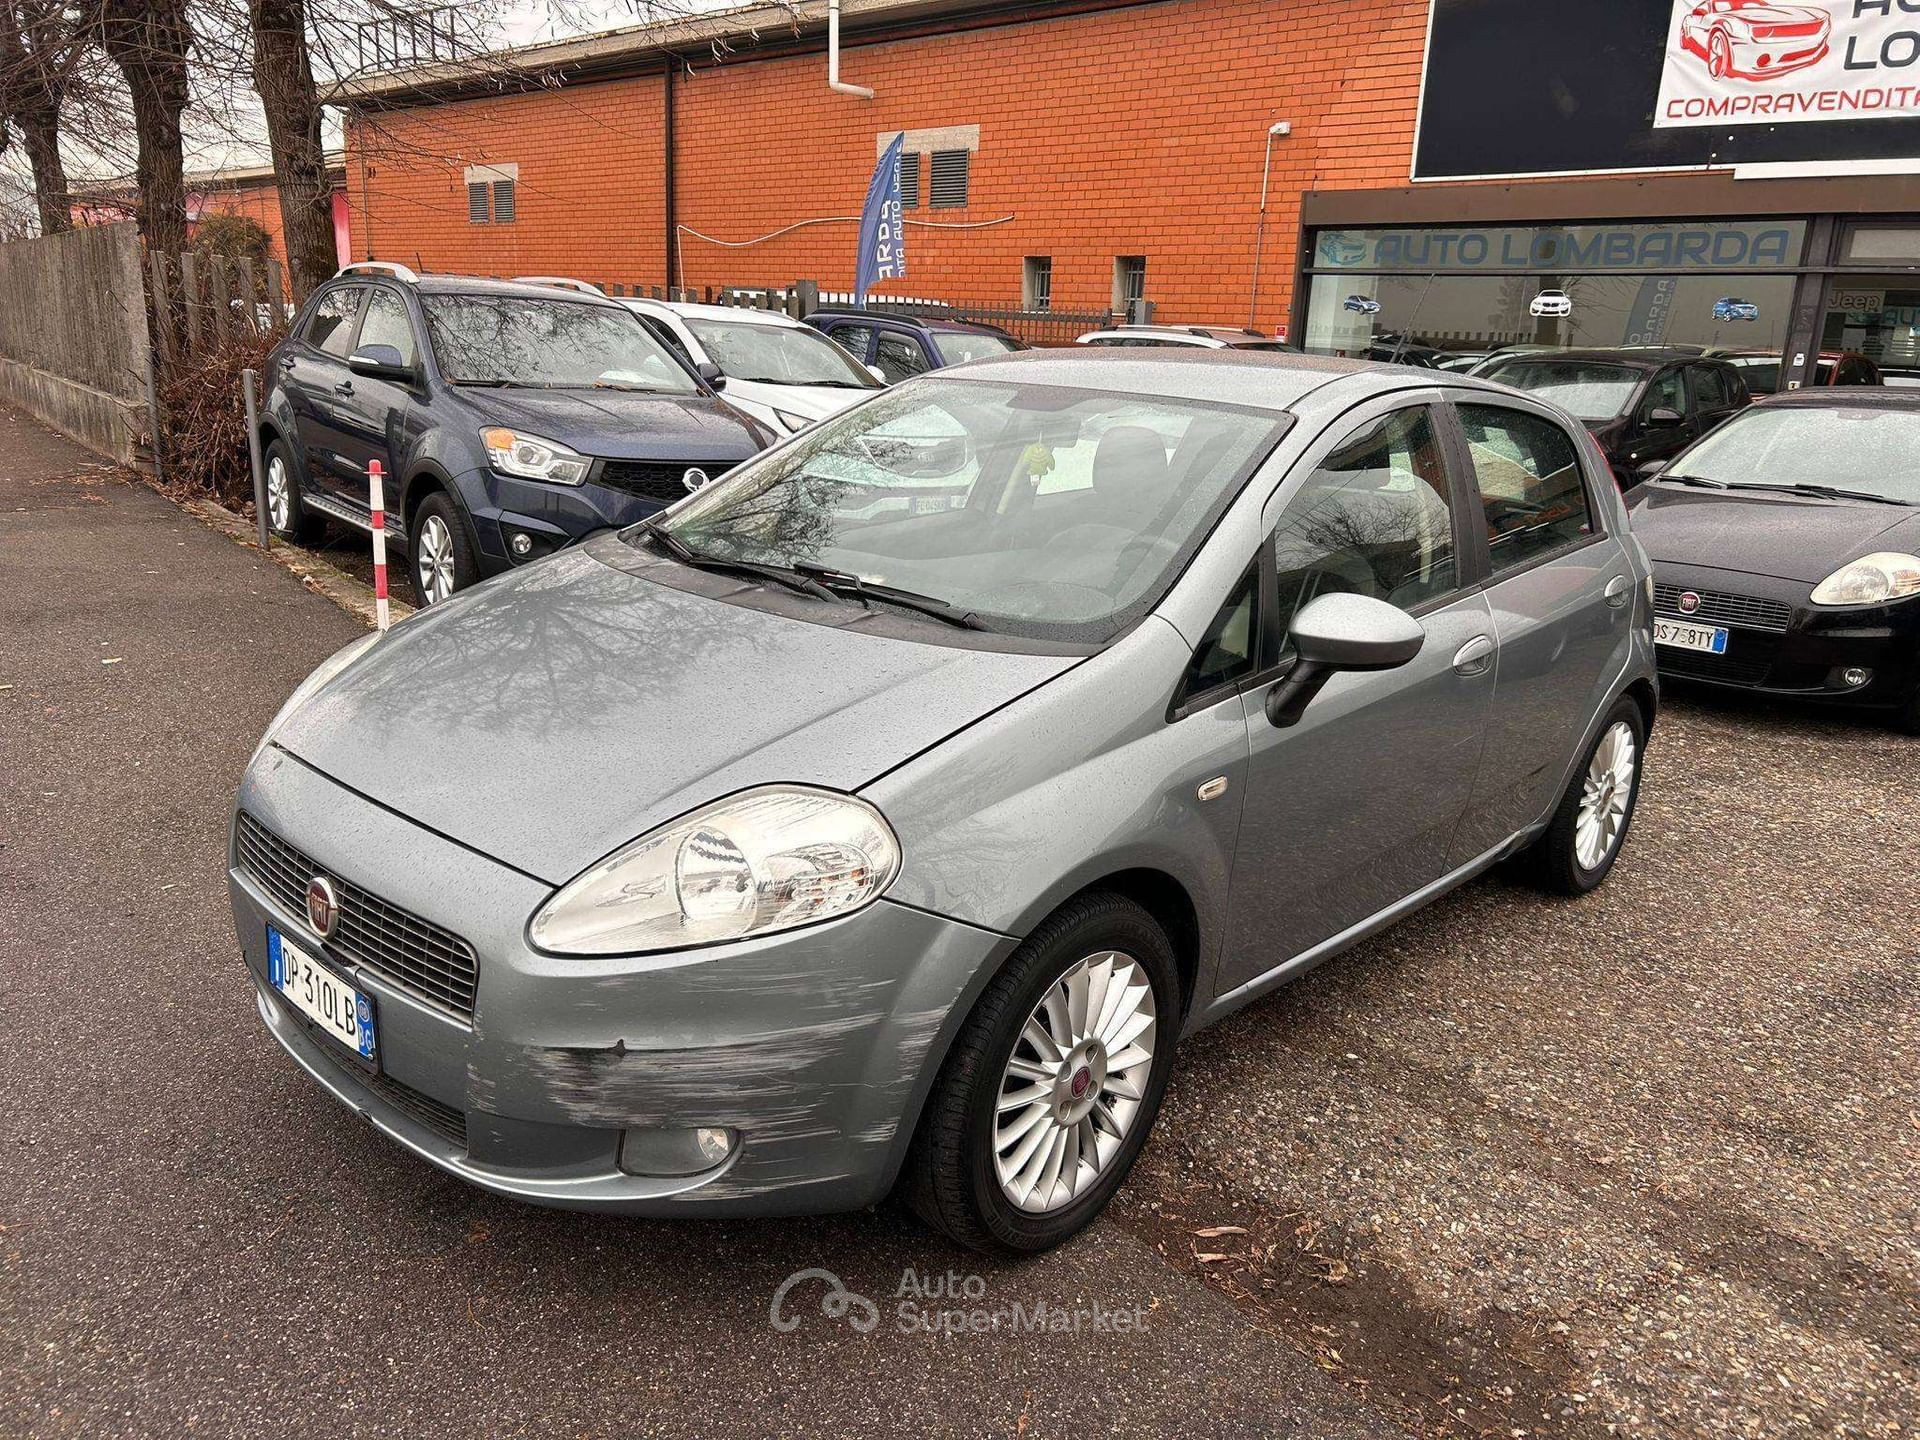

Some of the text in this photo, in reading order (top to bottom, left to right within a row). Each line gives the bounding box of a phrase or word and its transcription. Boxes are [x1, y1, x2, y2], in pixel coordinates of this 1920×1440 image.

[891, 200, 903, 240] AUTO
[1373, 229, 1790, 268] AUTO LOMBARDA
[1828, 290, 1881, 312] Jeep
[1682, 597, 1696, 607] FIAT
[310, 893, 328, 925] FIAT
[282, 947, 356, 1036] DP 310LB
[358, 1023, 374, 1052] BG
